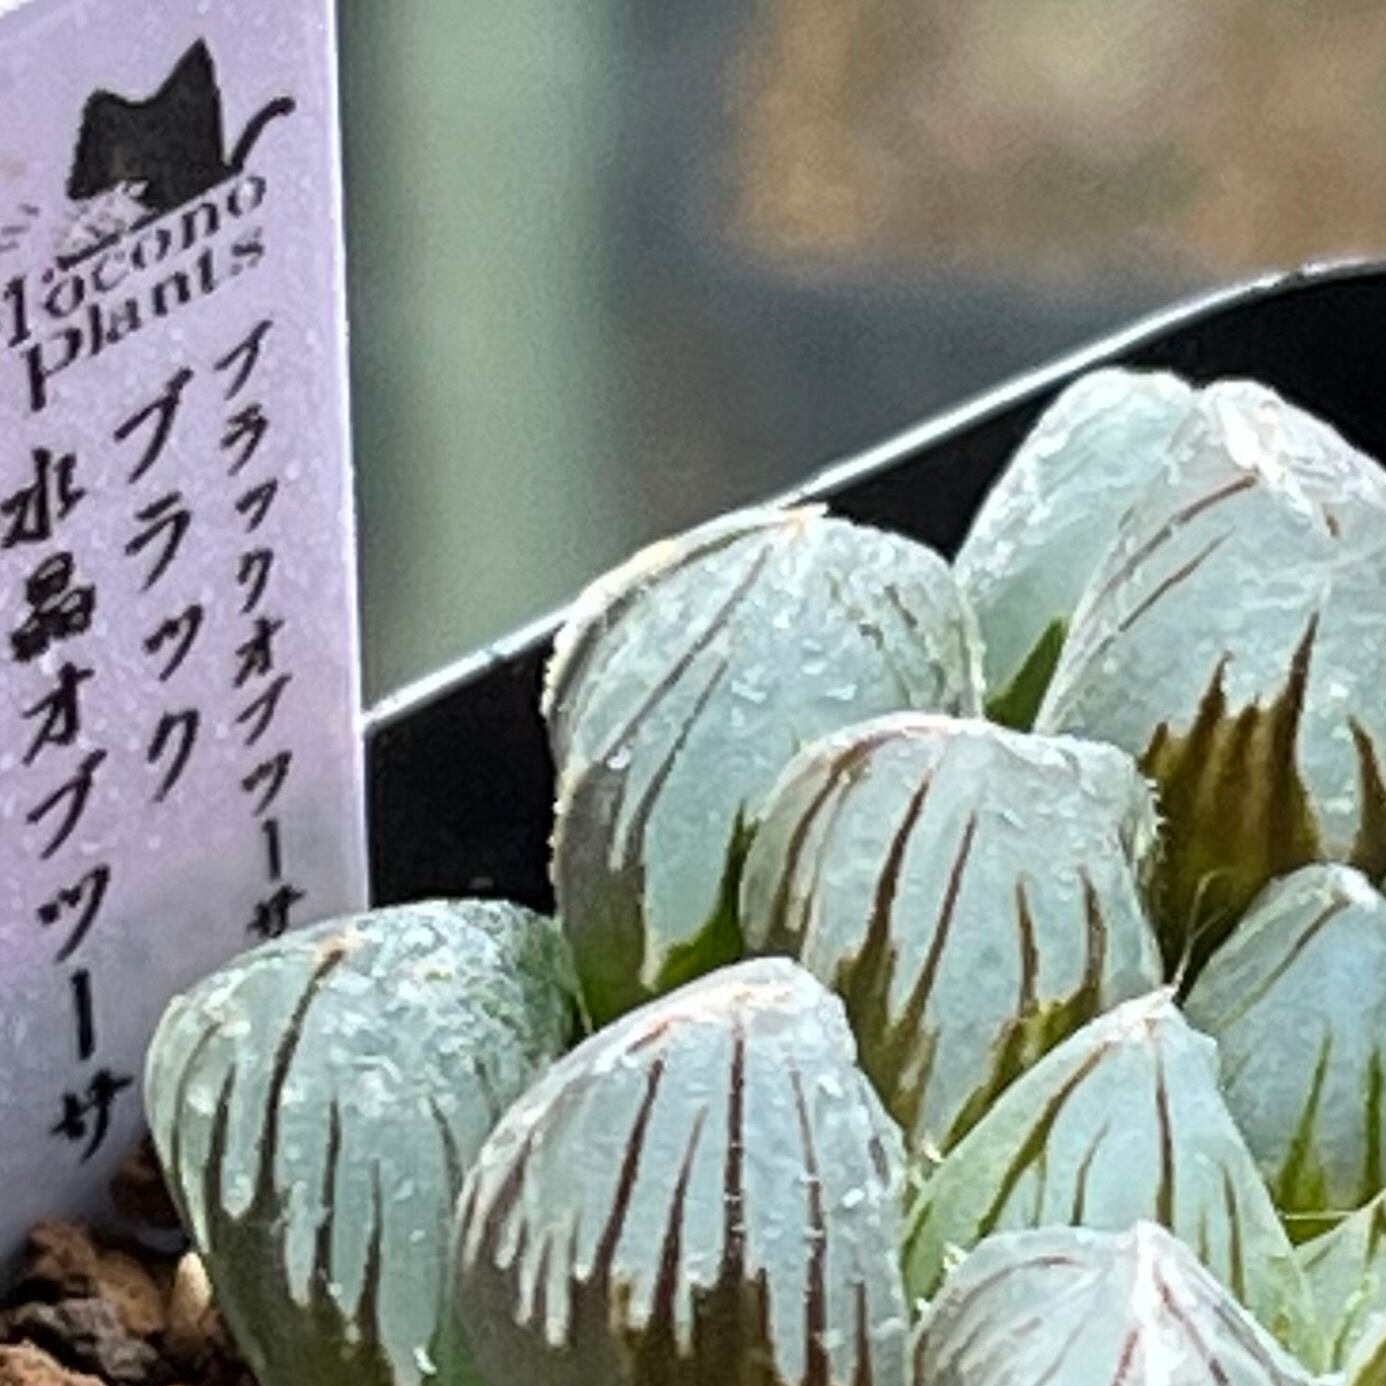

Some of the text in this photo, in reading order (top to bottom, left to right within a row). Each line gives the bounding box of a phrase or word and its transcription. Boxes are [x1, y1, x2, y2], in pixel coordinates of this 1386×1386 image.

[0, 447, 135, 1165] 水晶オブツーサ
[112, 366, 205, 802] ブラック
